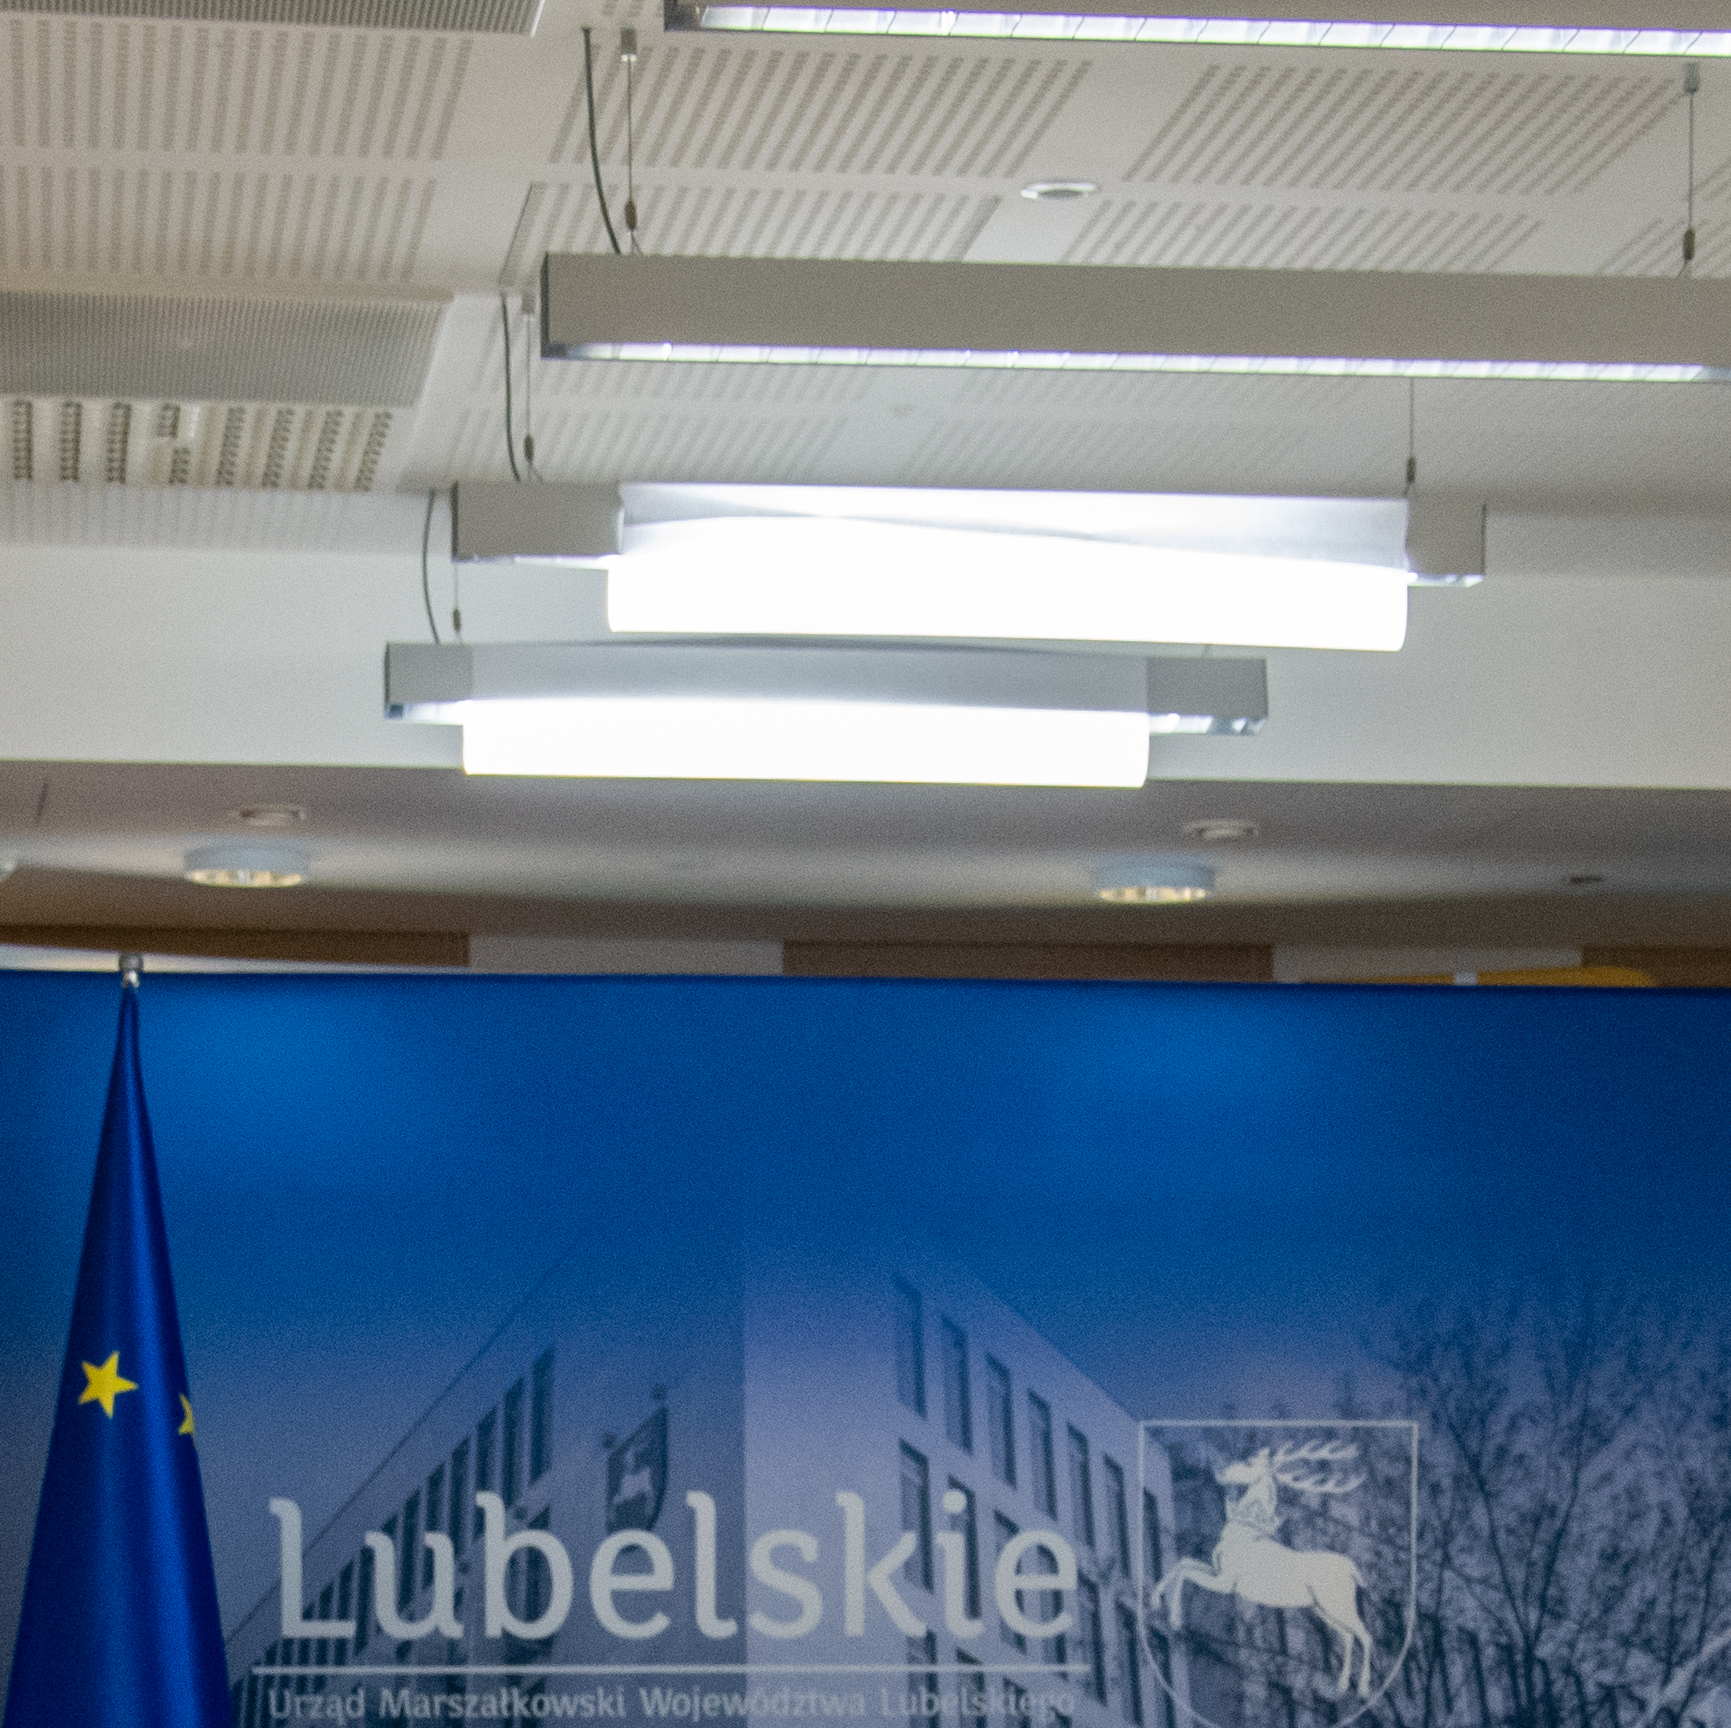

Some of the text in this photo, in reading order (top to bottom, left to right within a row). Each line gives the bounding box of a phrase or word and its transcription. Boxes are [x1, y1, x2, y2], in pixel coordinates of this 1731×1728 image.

[269, 1489, 1078, 1640] Lubelskie
[268, 1685, 1077, 1726] Urząd Marszałkowski Województwa Lubelskiego
